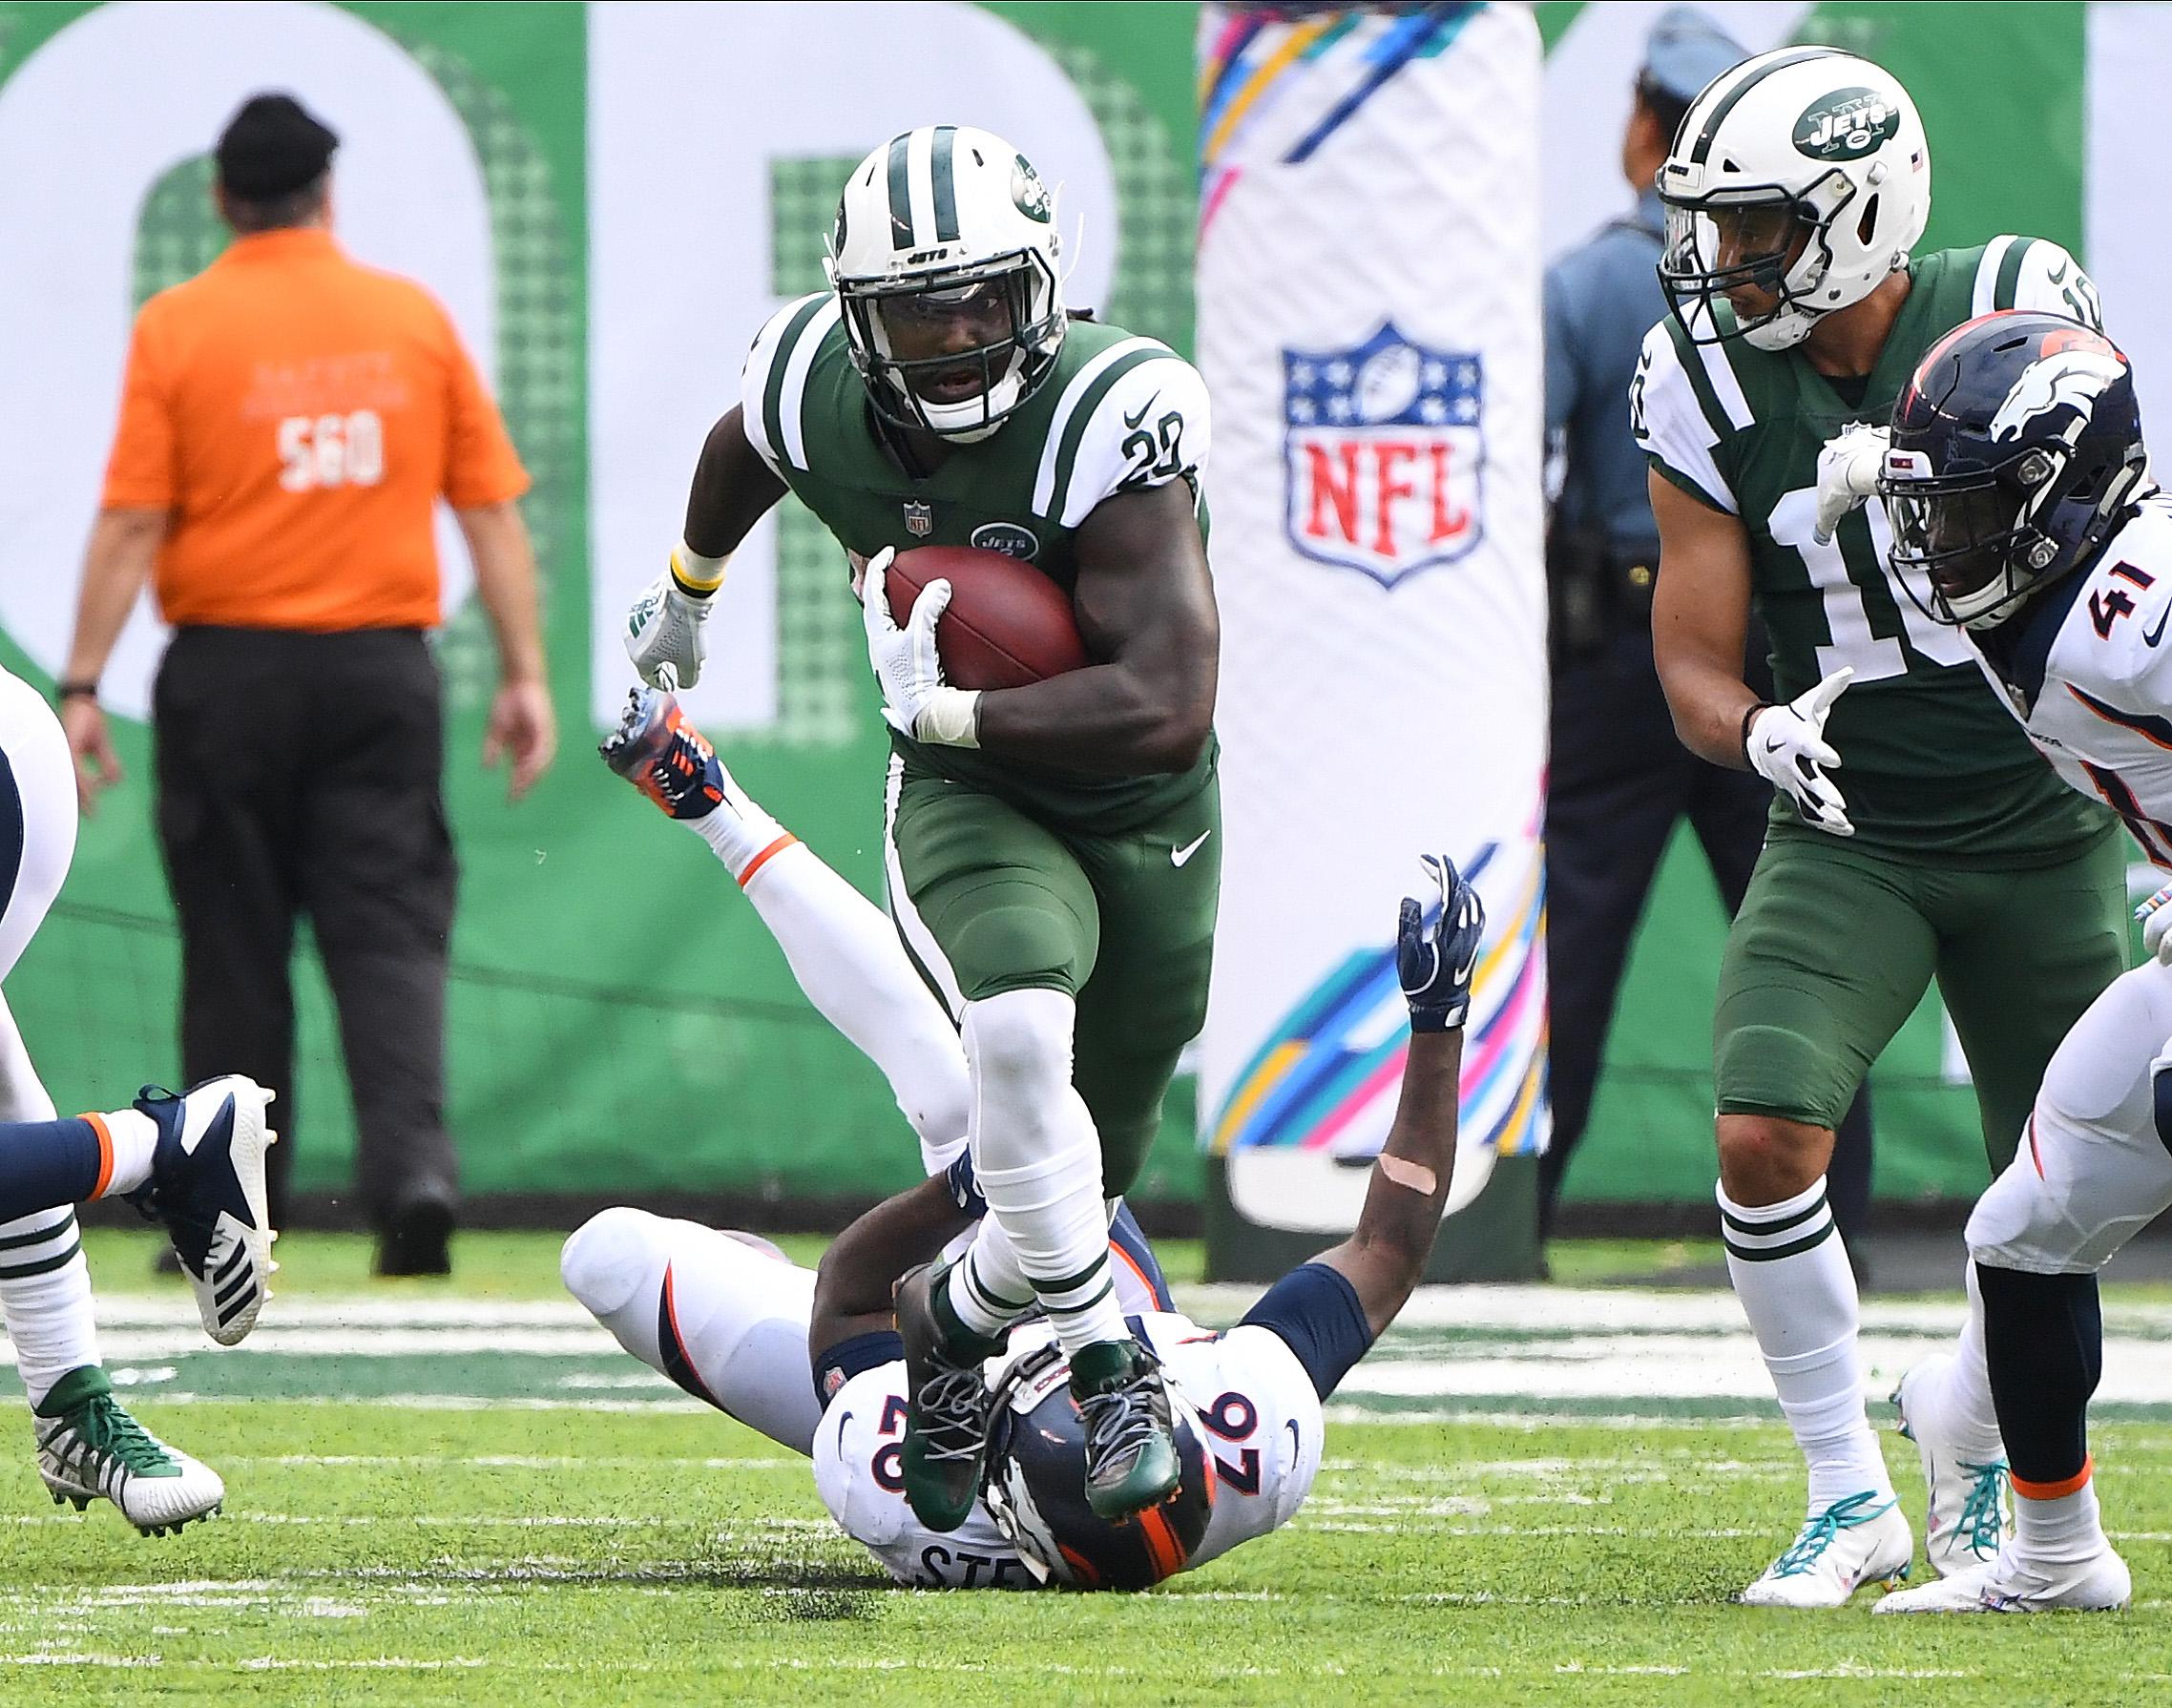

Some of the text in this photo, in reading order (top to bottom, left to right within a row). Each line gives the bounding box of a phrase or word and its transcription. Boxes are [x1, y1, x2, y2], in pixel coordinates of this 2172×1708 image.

[1809, 103, 1887, 146] JETS
[908, 248, 949, 264] JETS
[278, 411, 385, 493] 560
[1118, 411, 1183, 489] 20
[1304, 442, 1471, 558] NFL
[981, 536, 1027, 549] JETS
[2087, 559, 2157, 641] 41
